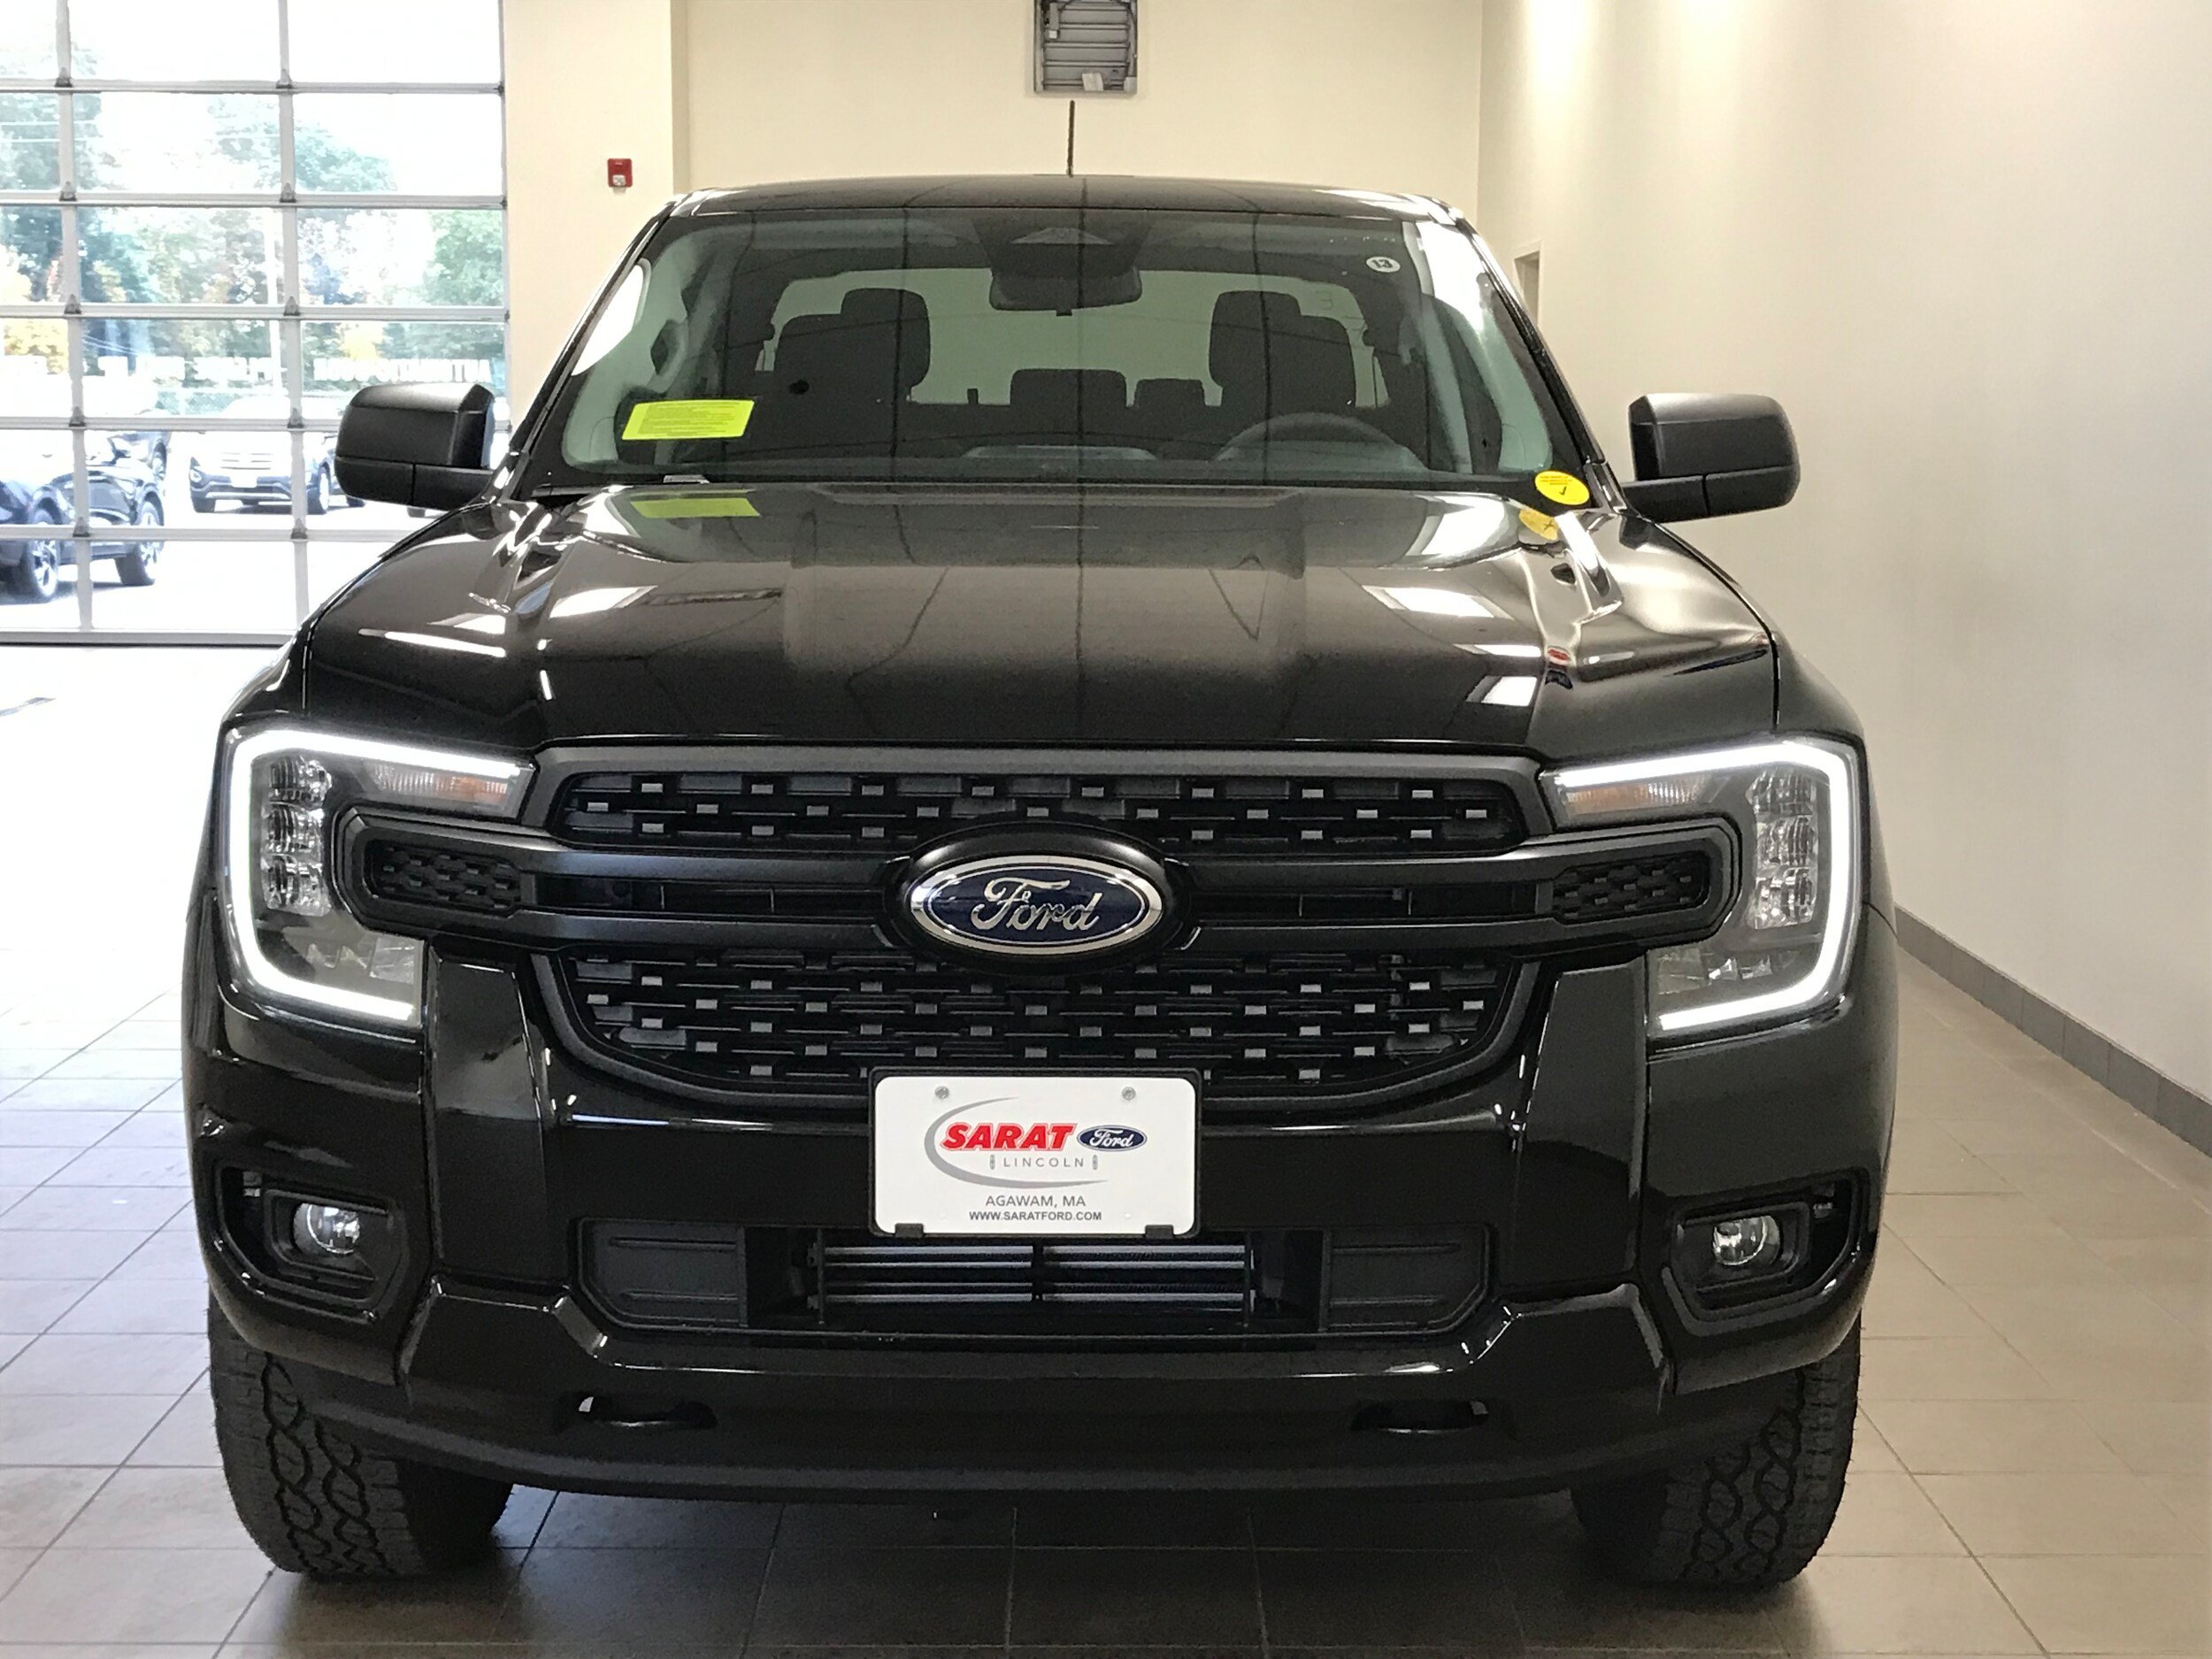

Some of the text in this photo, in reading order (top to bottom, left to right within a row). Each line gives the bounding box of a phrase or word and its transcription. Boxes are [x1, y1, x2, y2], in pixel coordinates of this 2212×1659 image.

[971, 877, 1103, 930] Ford
[940, 1122, 1134, 1150] SARAT Ford
[1002, 1156, 1085, 1168] LINCOLN
[986, 1195, 1086, 1208] AGAWAM, MA
[969, 1211, 1102, 1221] WWW.SARATFORD.COM
